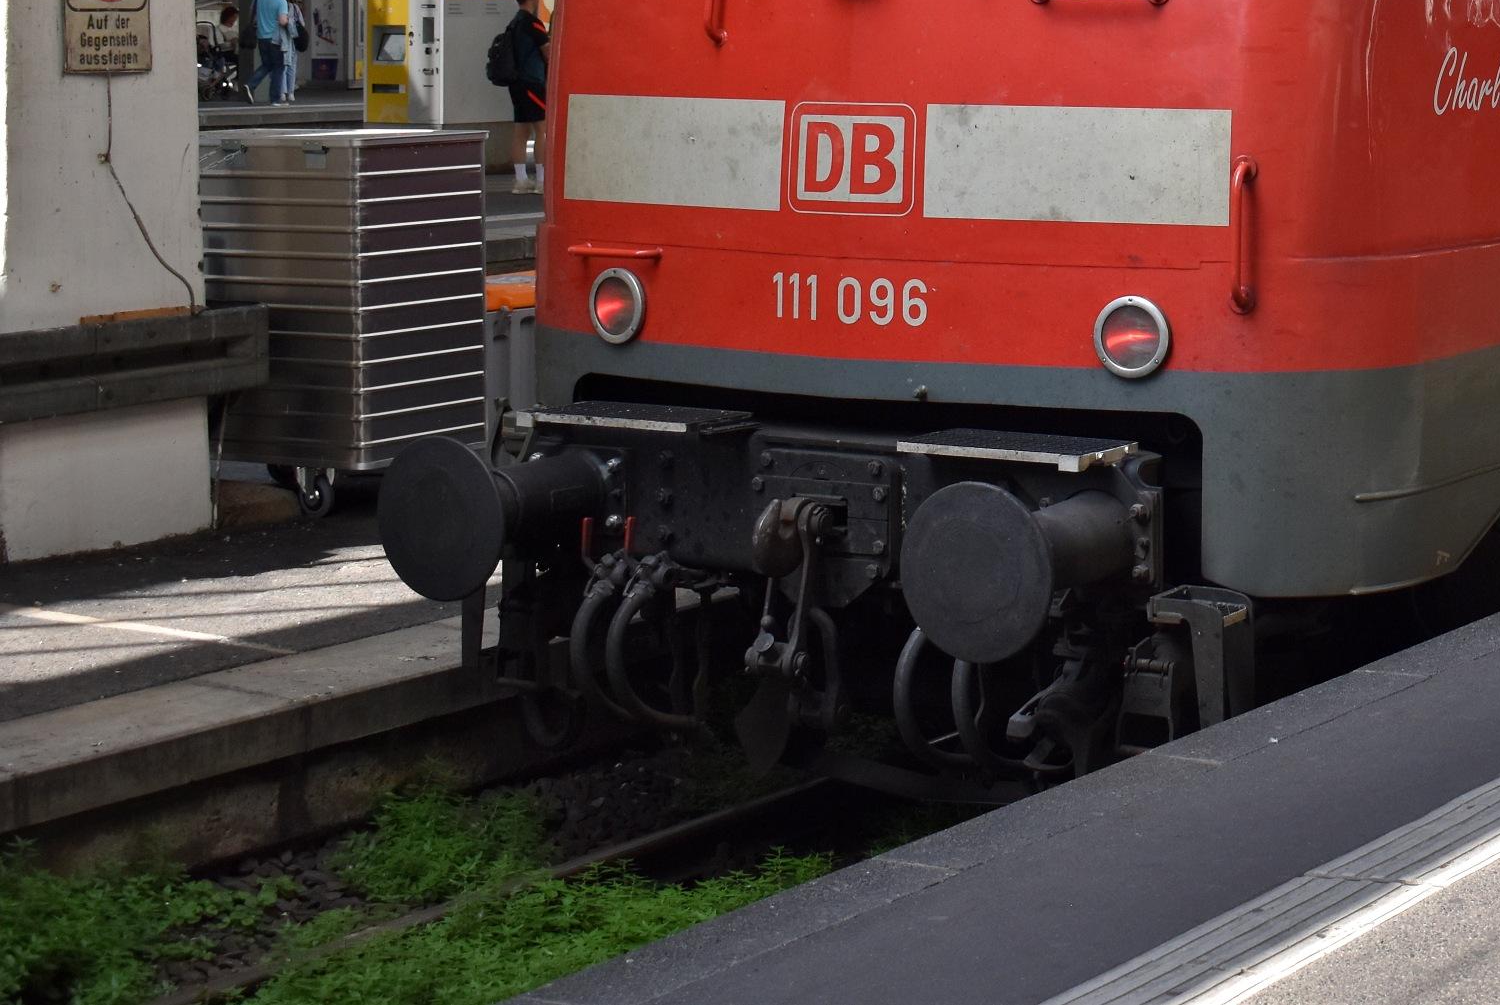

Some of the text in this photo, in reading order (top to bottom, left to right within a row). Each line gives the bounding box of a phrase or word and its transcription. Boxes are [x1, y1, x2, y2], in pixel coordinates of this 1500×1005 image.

[87, 14, 131, 30] Auf der
[80, 32, 138, 51] Gegenseite
[79, 50, 138, 69] aussteigen
[804, 120, 897, 195] DB
[772, 271, 928, 327] 111 096
